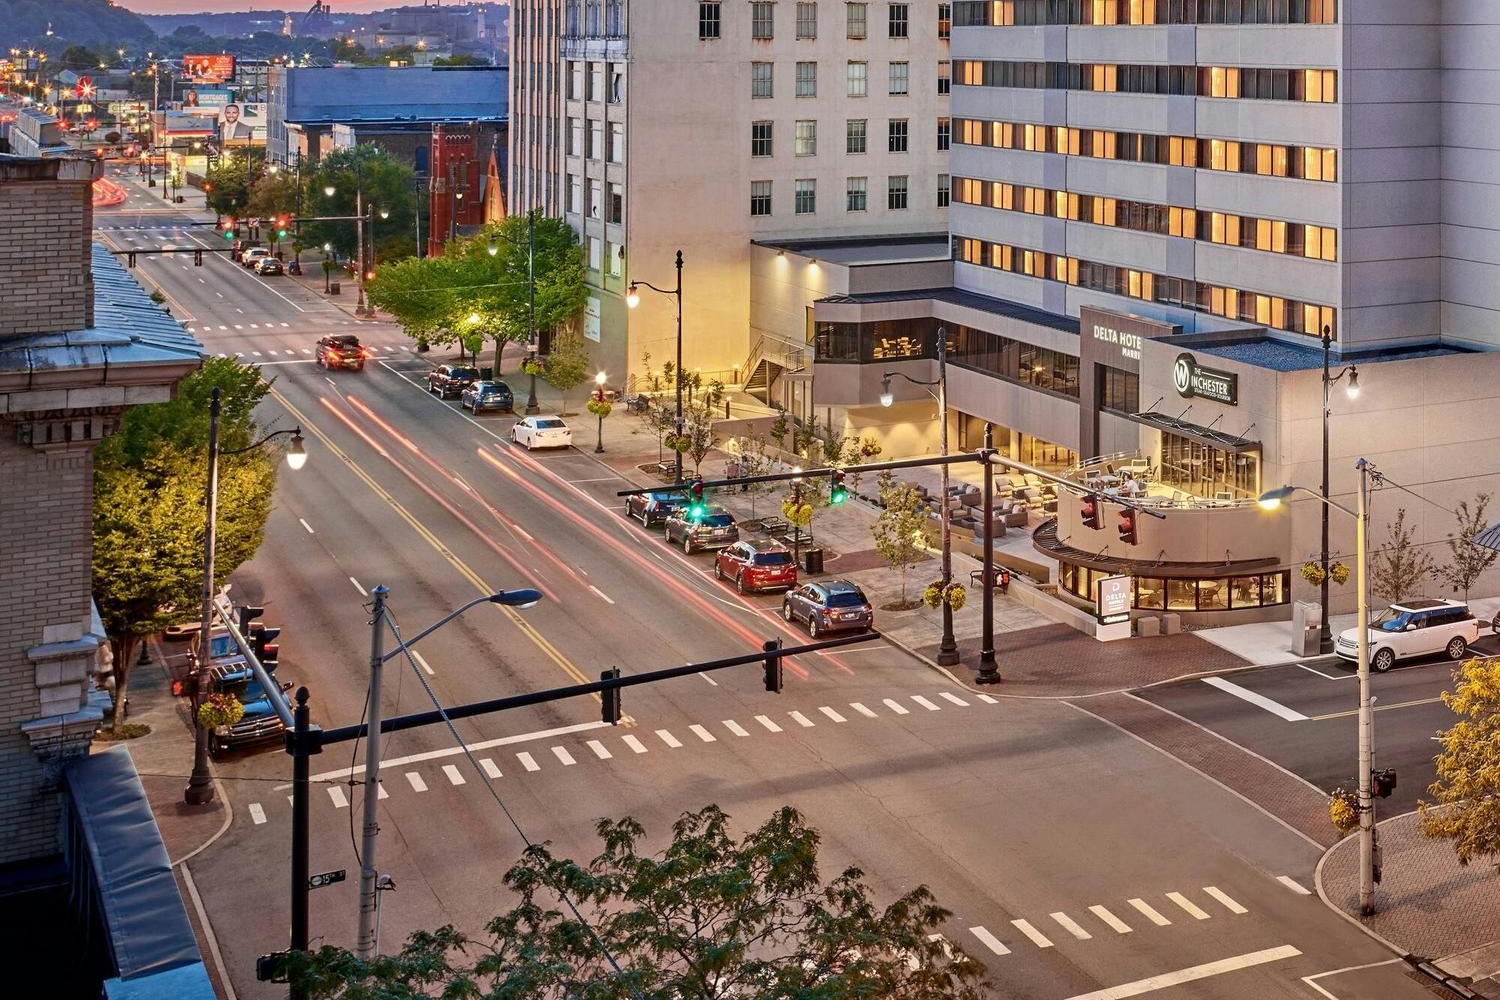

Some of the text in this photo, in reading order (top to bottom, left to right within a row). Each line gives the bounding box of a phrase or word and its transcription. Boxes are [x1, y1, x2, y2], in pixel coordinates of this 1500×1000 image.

[1093, 325, 1141, 350] DELTA HOTE
[1122, 347, 1140, 360] MARRI
[1105, 592, 1127, 601] DELTA
